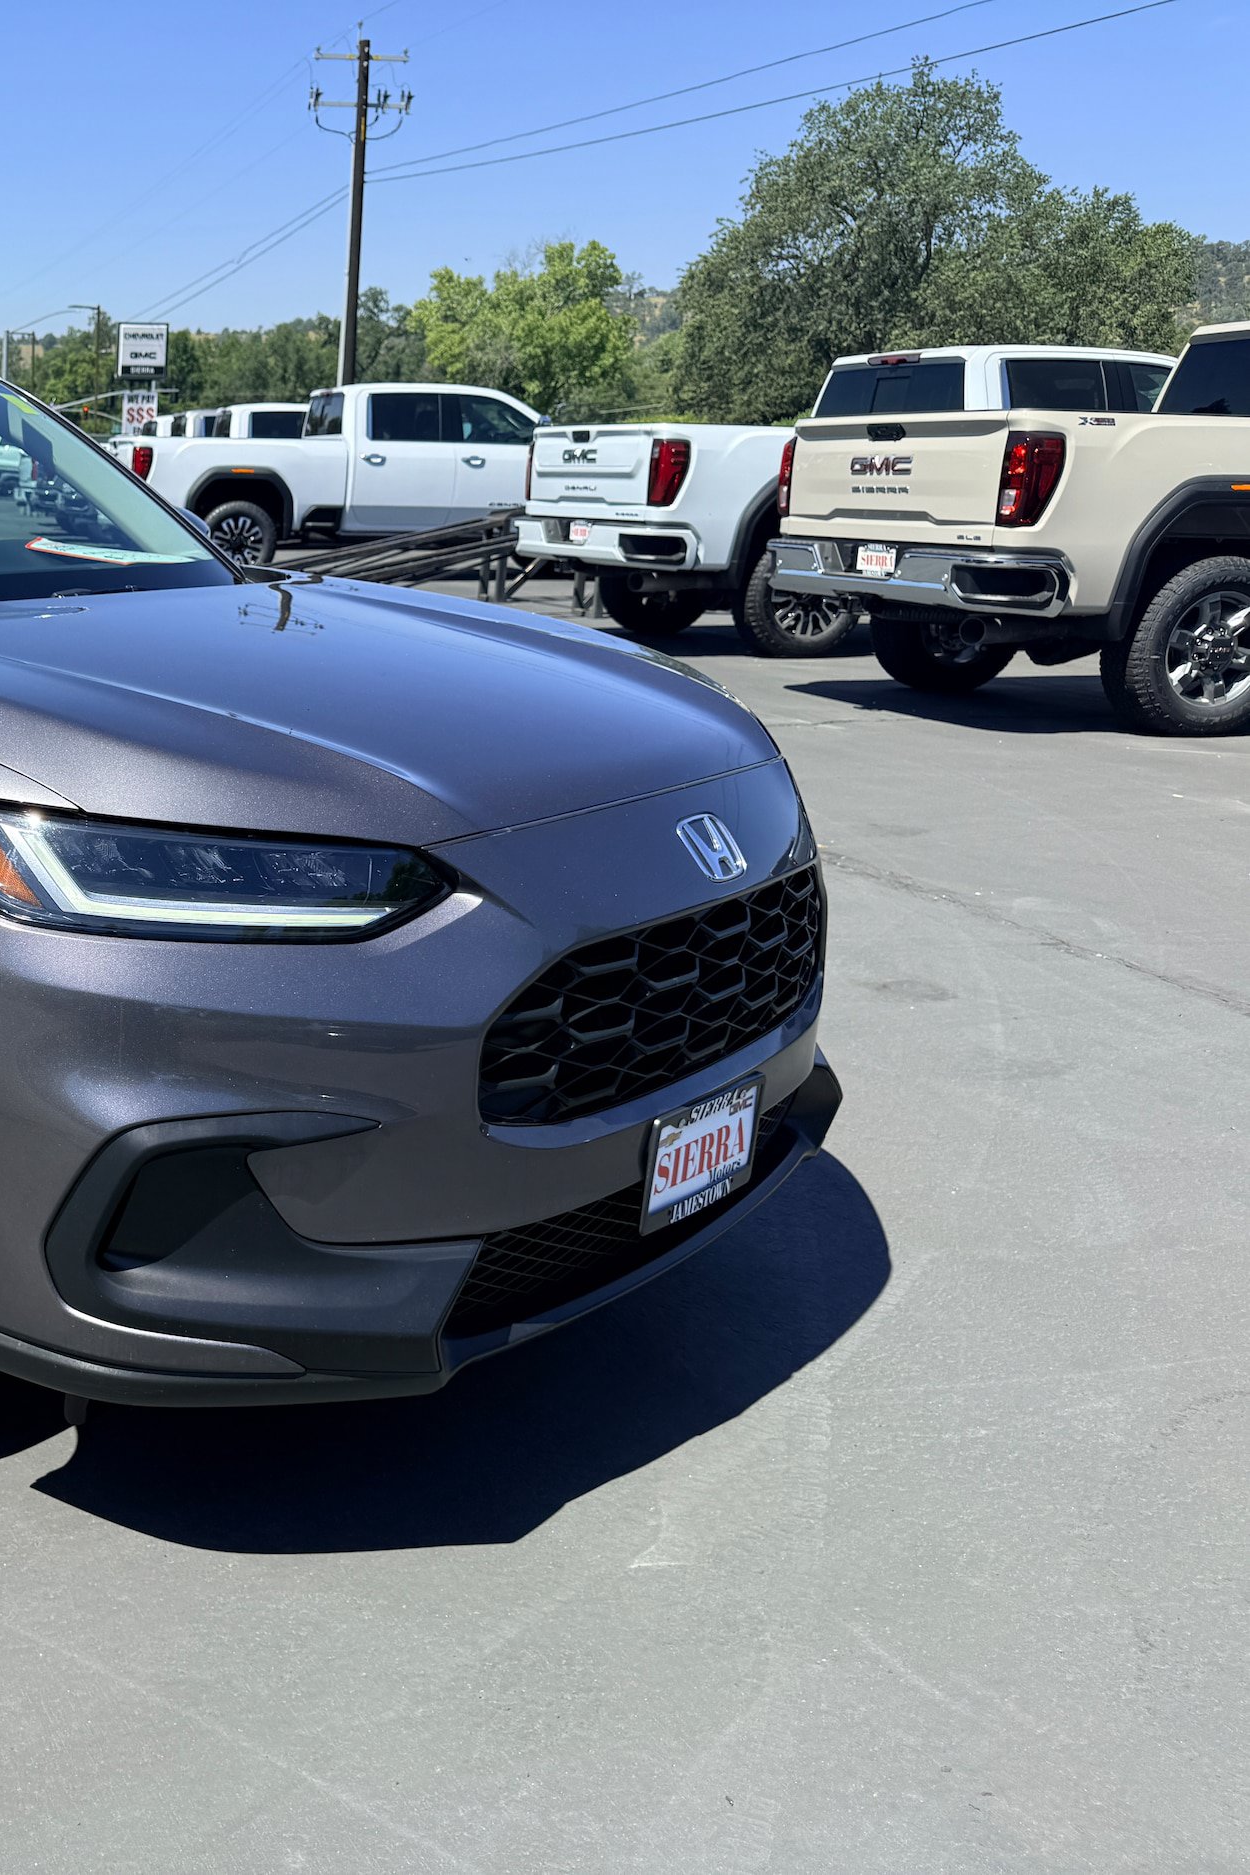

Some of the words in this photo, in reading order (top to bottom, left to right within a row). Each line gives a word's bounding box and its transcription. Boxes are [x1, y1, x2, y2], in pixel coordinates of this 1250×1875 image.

[123, 332, 165, 341] CHEVROLET
[129, 351, 157, 360] GMC
[562, 448, 598, 464] GMC
[850, 455, 913, 476] GMC
[860, 554, 894, 568] SIERRA
[690, 1088, 742, 1124] SIERRA
[653, 1117, 746, 1196] SIERRA
[669, 1175, 733, 1225] JAMESTOWN
